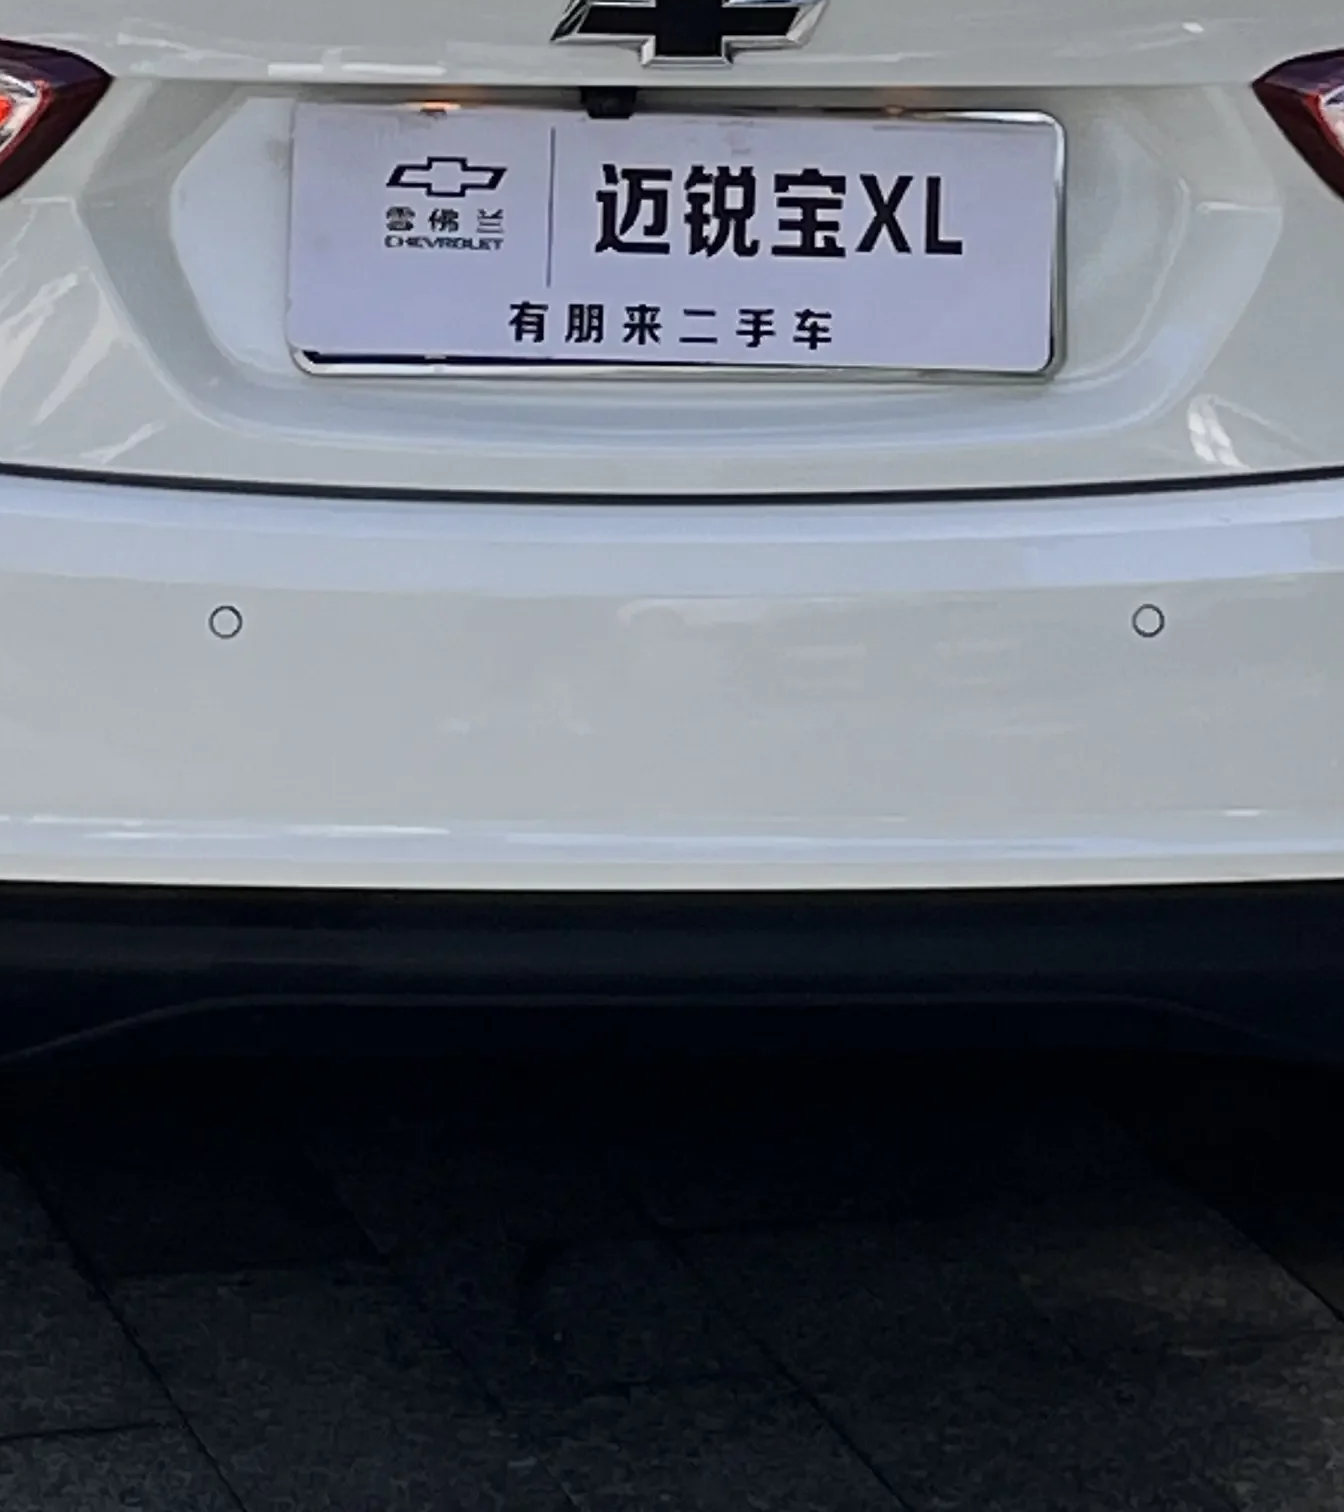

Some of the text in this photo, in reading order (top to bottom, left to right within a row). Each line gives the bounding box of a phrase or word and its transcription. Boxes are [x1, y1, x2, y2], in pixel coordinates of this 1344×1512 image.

[595, 162, 964, 259] 迈锐宝XL
[509, 300, 833, 349] 有朋来二手车
